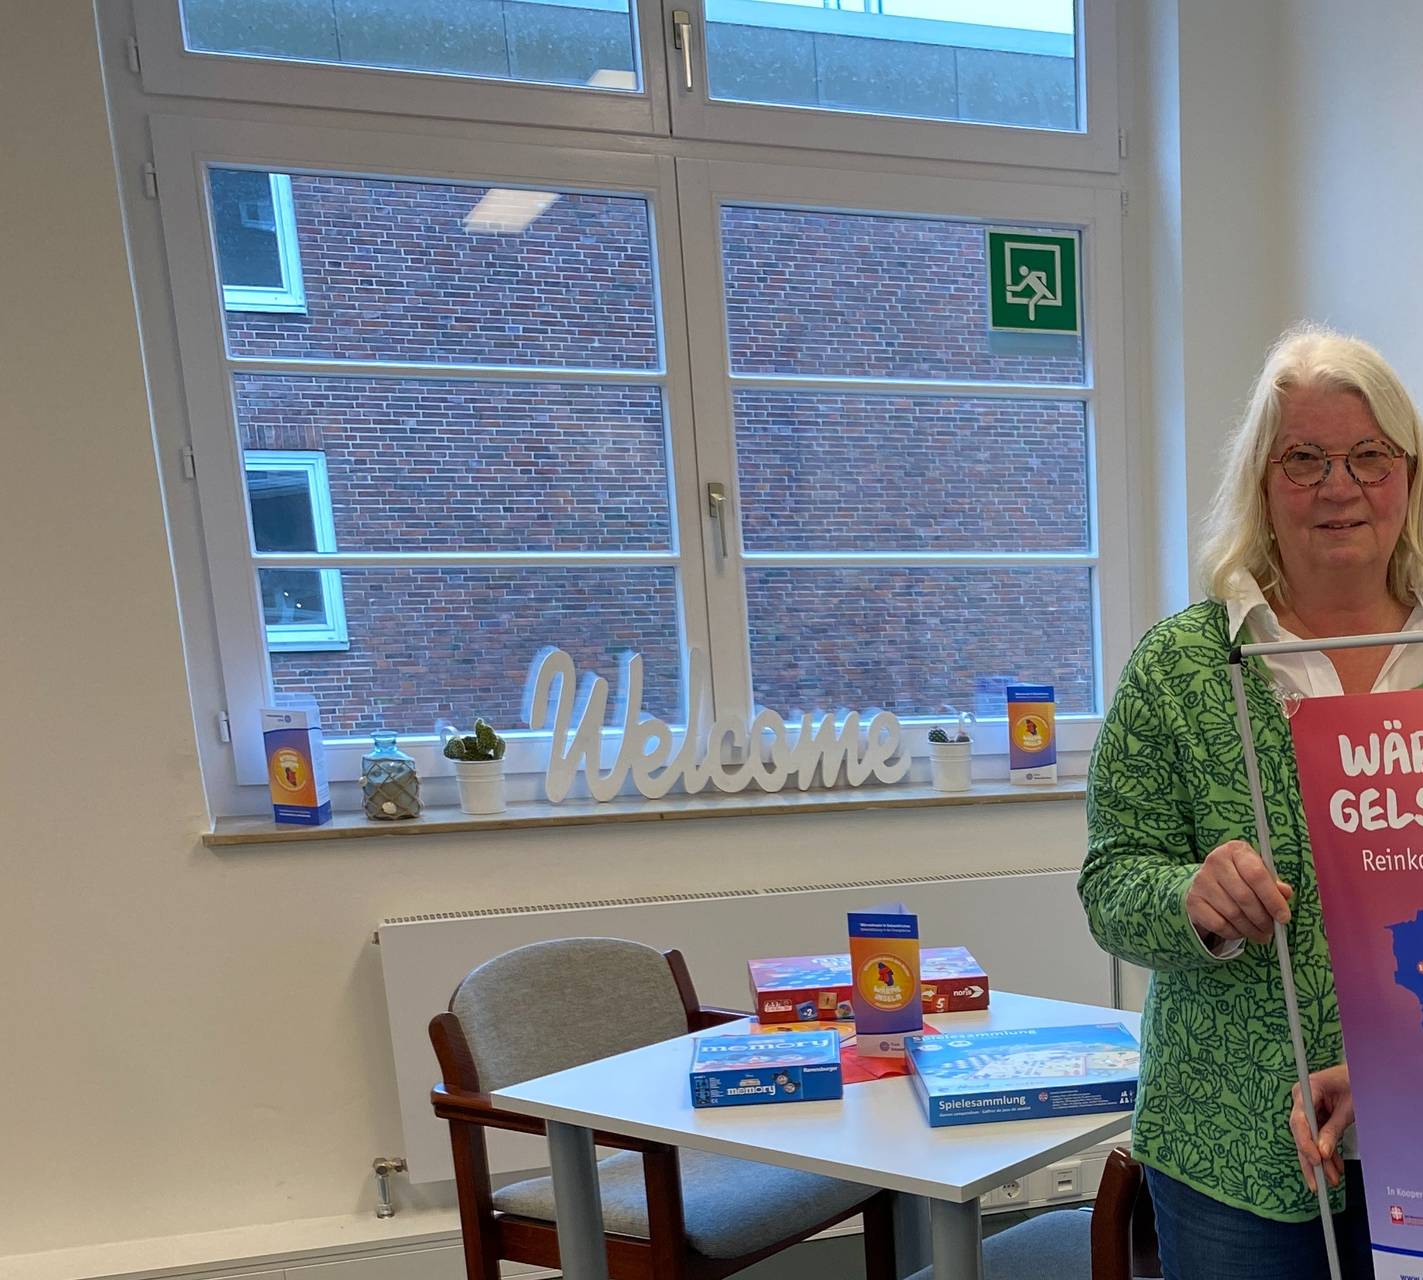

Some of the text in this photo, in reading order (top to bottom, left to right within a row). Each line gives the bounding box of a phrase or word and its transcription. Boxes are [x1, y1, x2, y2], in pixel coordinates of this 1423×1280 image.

[530, 648, 912, 802] Welcome
[953, 987, 972, 997] noris
[935, 997, 945, 1008] 5
[912, 1029, 1037, 1042] Spielesammlung
[702, 1039, 829, 1053] memory
[727, 1083, 776, 1096] memory
[939, 1096, 1026, 1111] Spielesammlung
[1386, 1186, 1395, 1196] In
